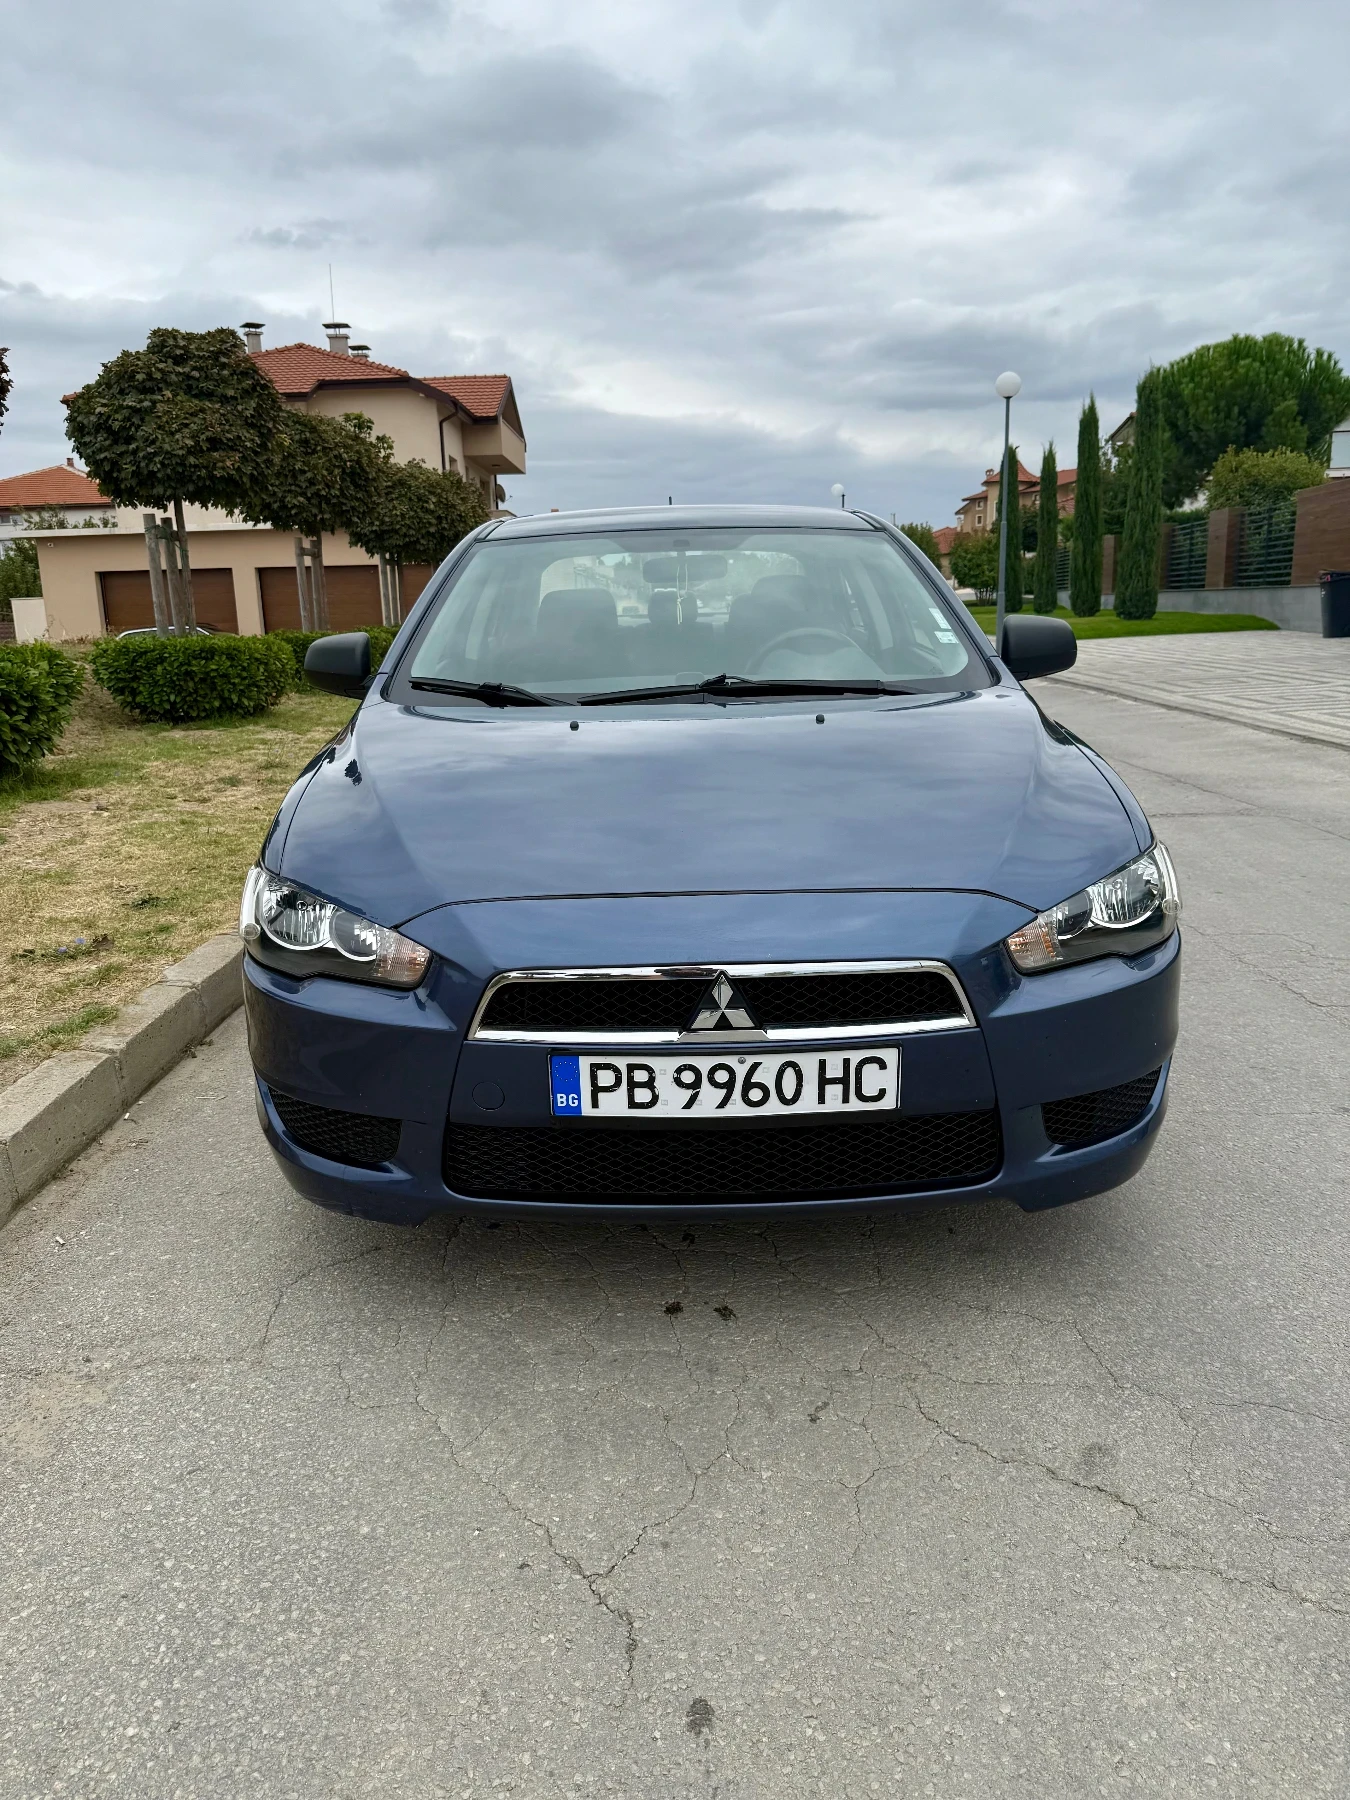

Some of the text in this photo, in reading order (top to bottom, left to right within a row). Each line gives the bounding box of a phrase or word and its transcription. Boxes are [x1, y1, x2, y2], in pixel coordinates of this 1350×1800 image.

[590, 1055, 888, 1109] PB 9960 HC
[556, 1093, 579, 1107] BG
